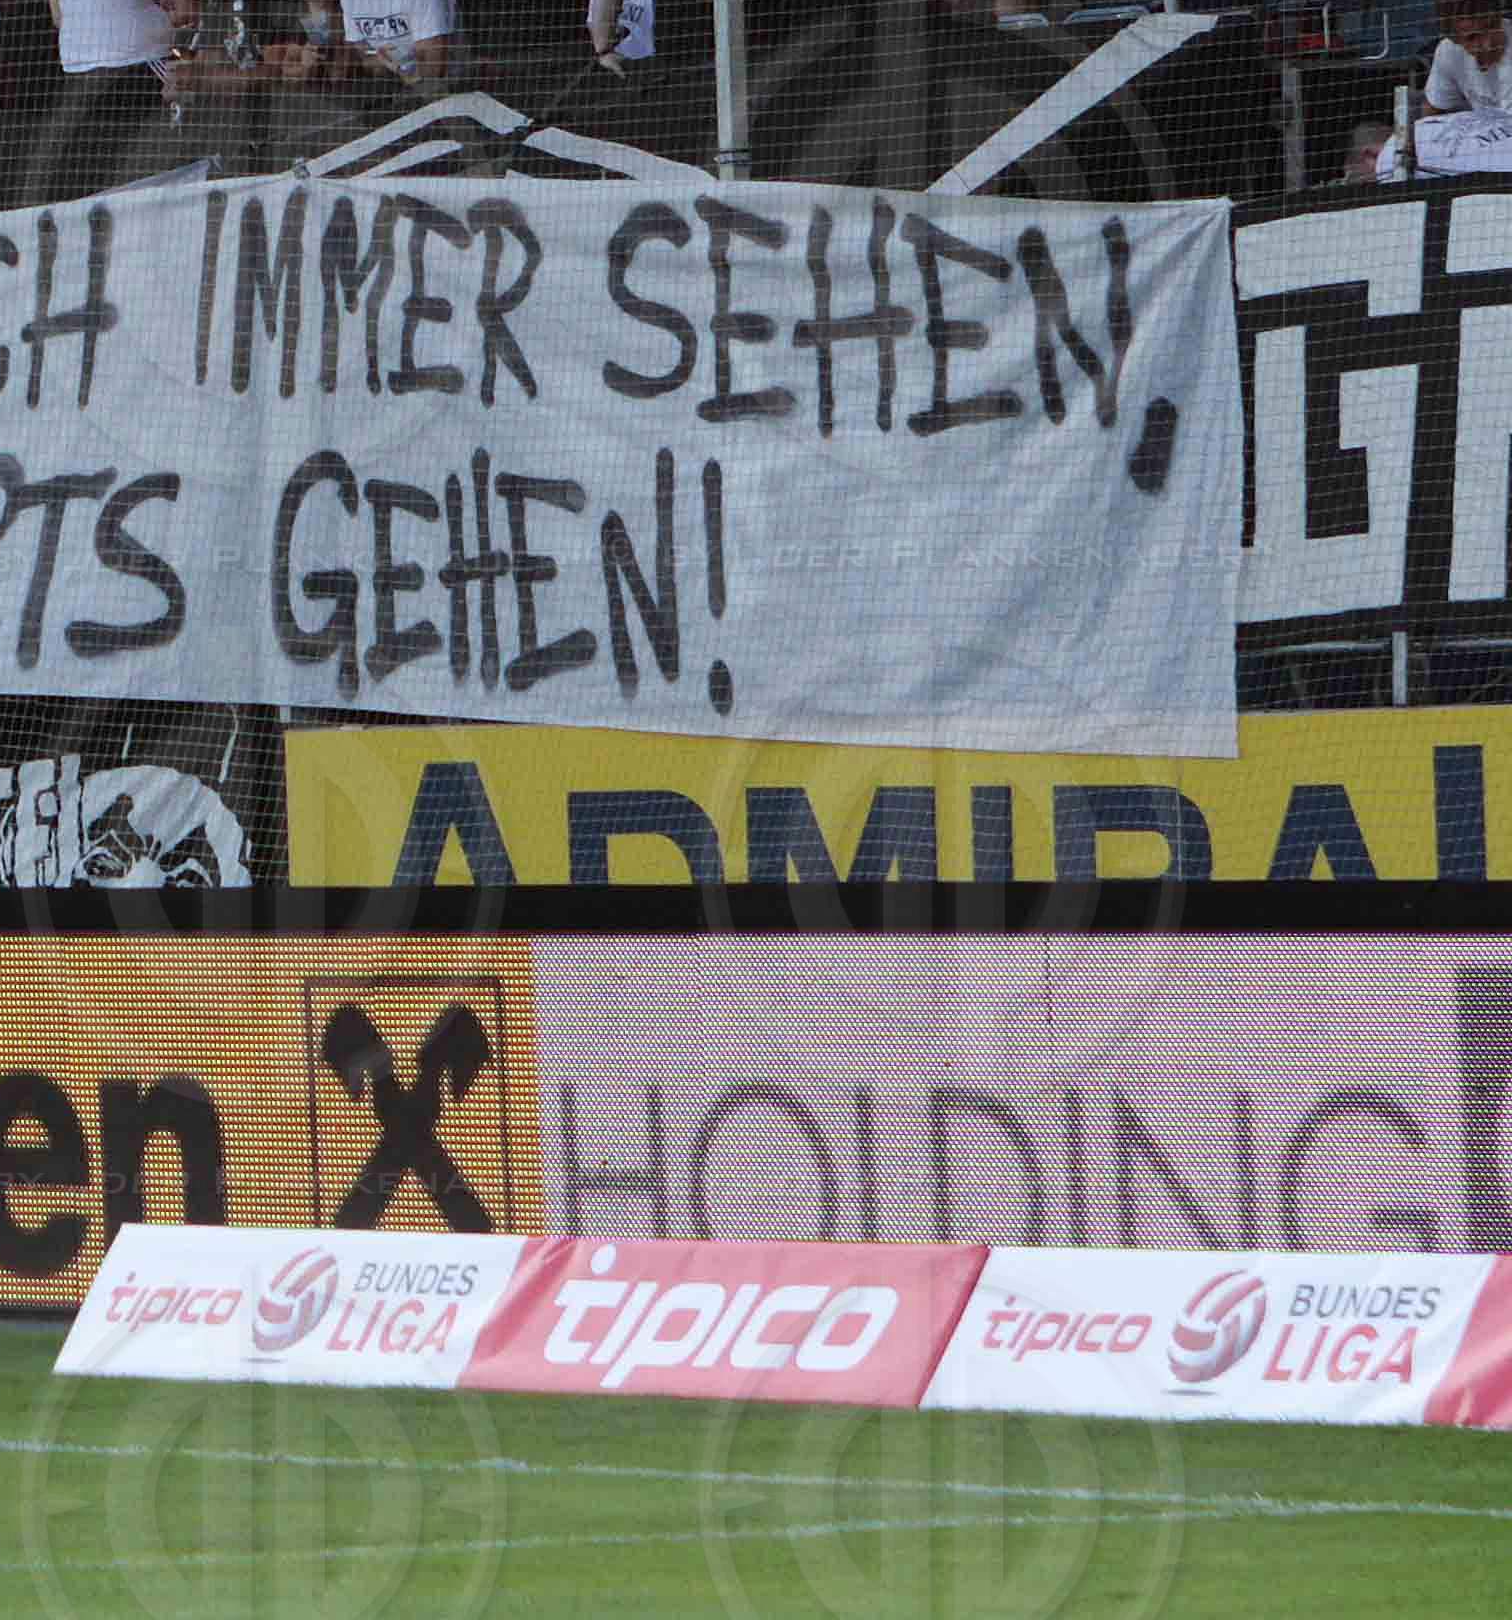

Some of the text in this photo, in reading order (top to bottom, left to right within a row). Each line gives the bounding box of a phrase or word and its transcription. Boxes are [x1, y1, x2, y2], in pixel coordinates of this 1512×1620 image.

[194, 184, 544, 408] IMMER
[603, 191, 1178, 494] SEHEN,
[270, 446, 731, 718] GEHEN!
[104, 1270, 243, 1333] tipico
[353, 1260, 479, 1297] BUNDES
[1287, 1282, 1441, 1322] BUNDES
[330, 1291, 460, 1355] LIGA
[543, 1242, 899, 1389] tipico
[982, 1293, 1154, 1361] tipico
[1261, 1322, 1419, 1385] LIGA
